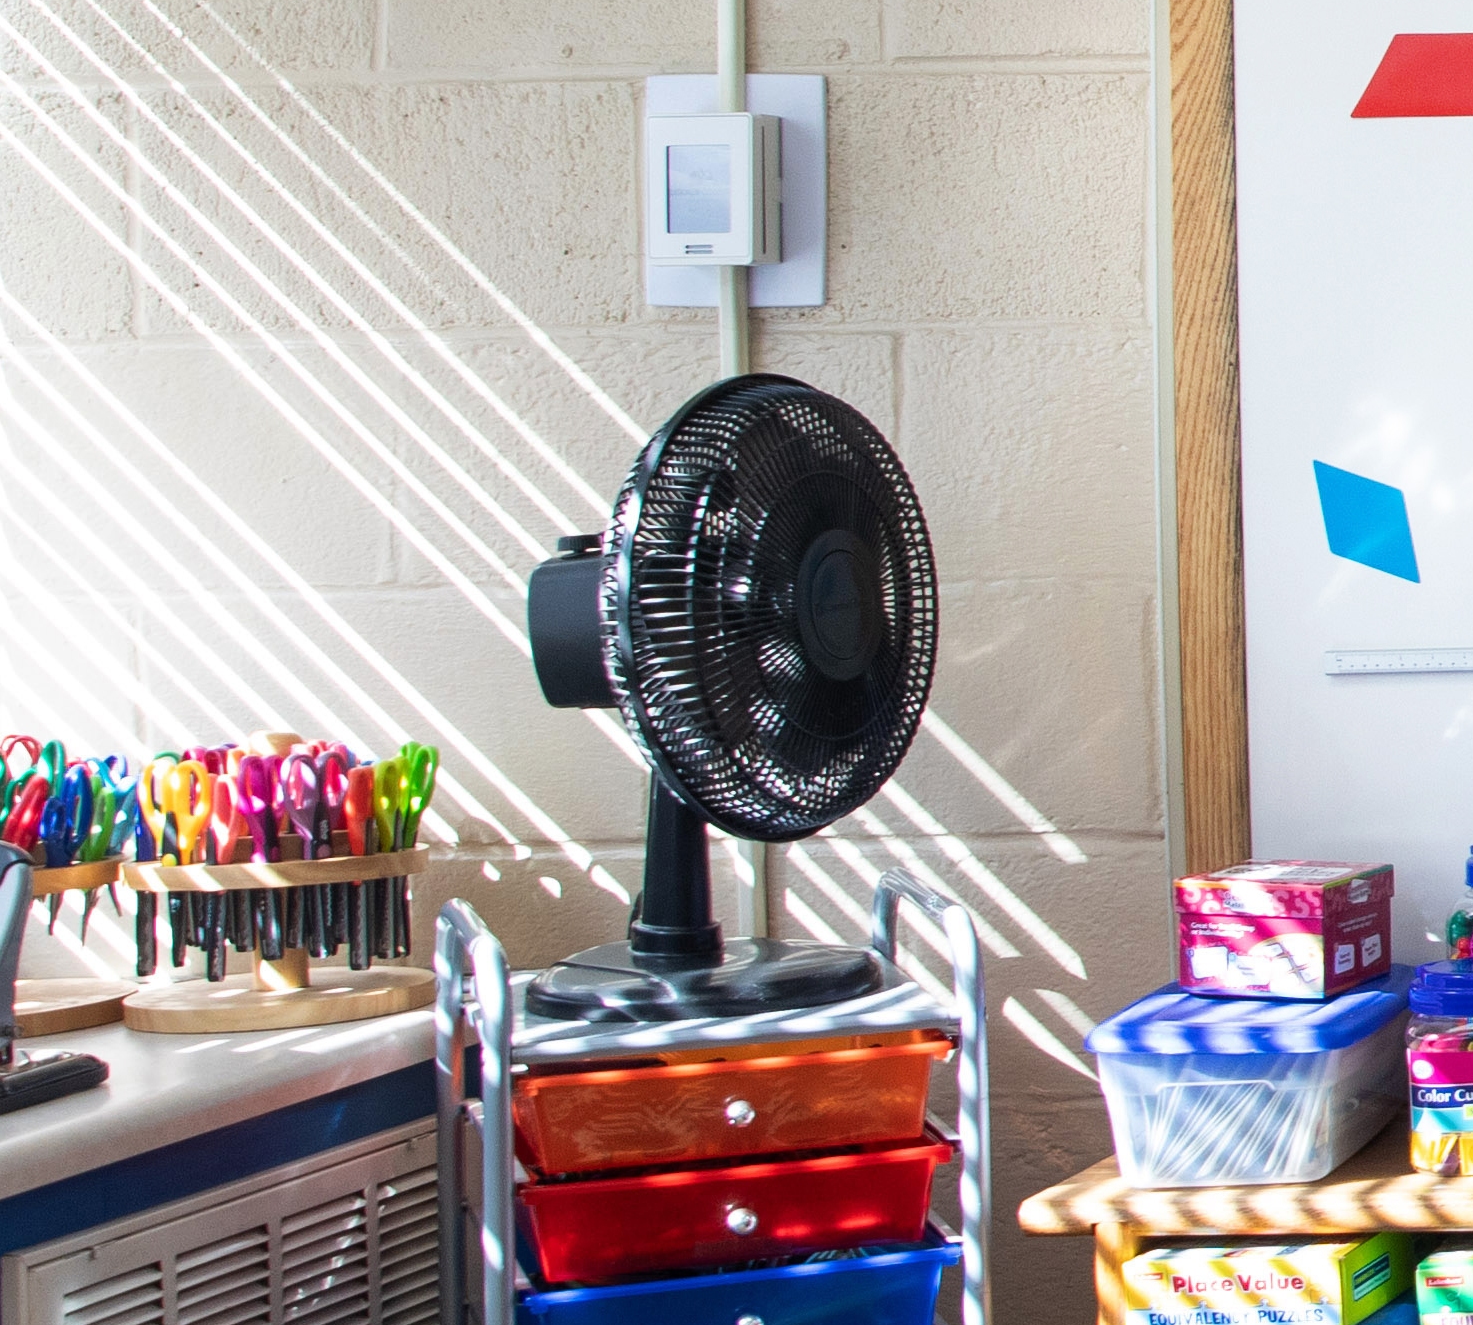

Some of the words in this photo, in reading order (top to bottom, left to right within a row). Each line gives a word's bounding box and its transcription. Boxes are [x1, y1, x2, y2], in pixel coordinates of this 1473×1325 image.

[1418, 1088, 1451, 1102] Color
[1172, 1276, 1234, 1293] Place
[1237, 1273, 1304, 1292] Value
